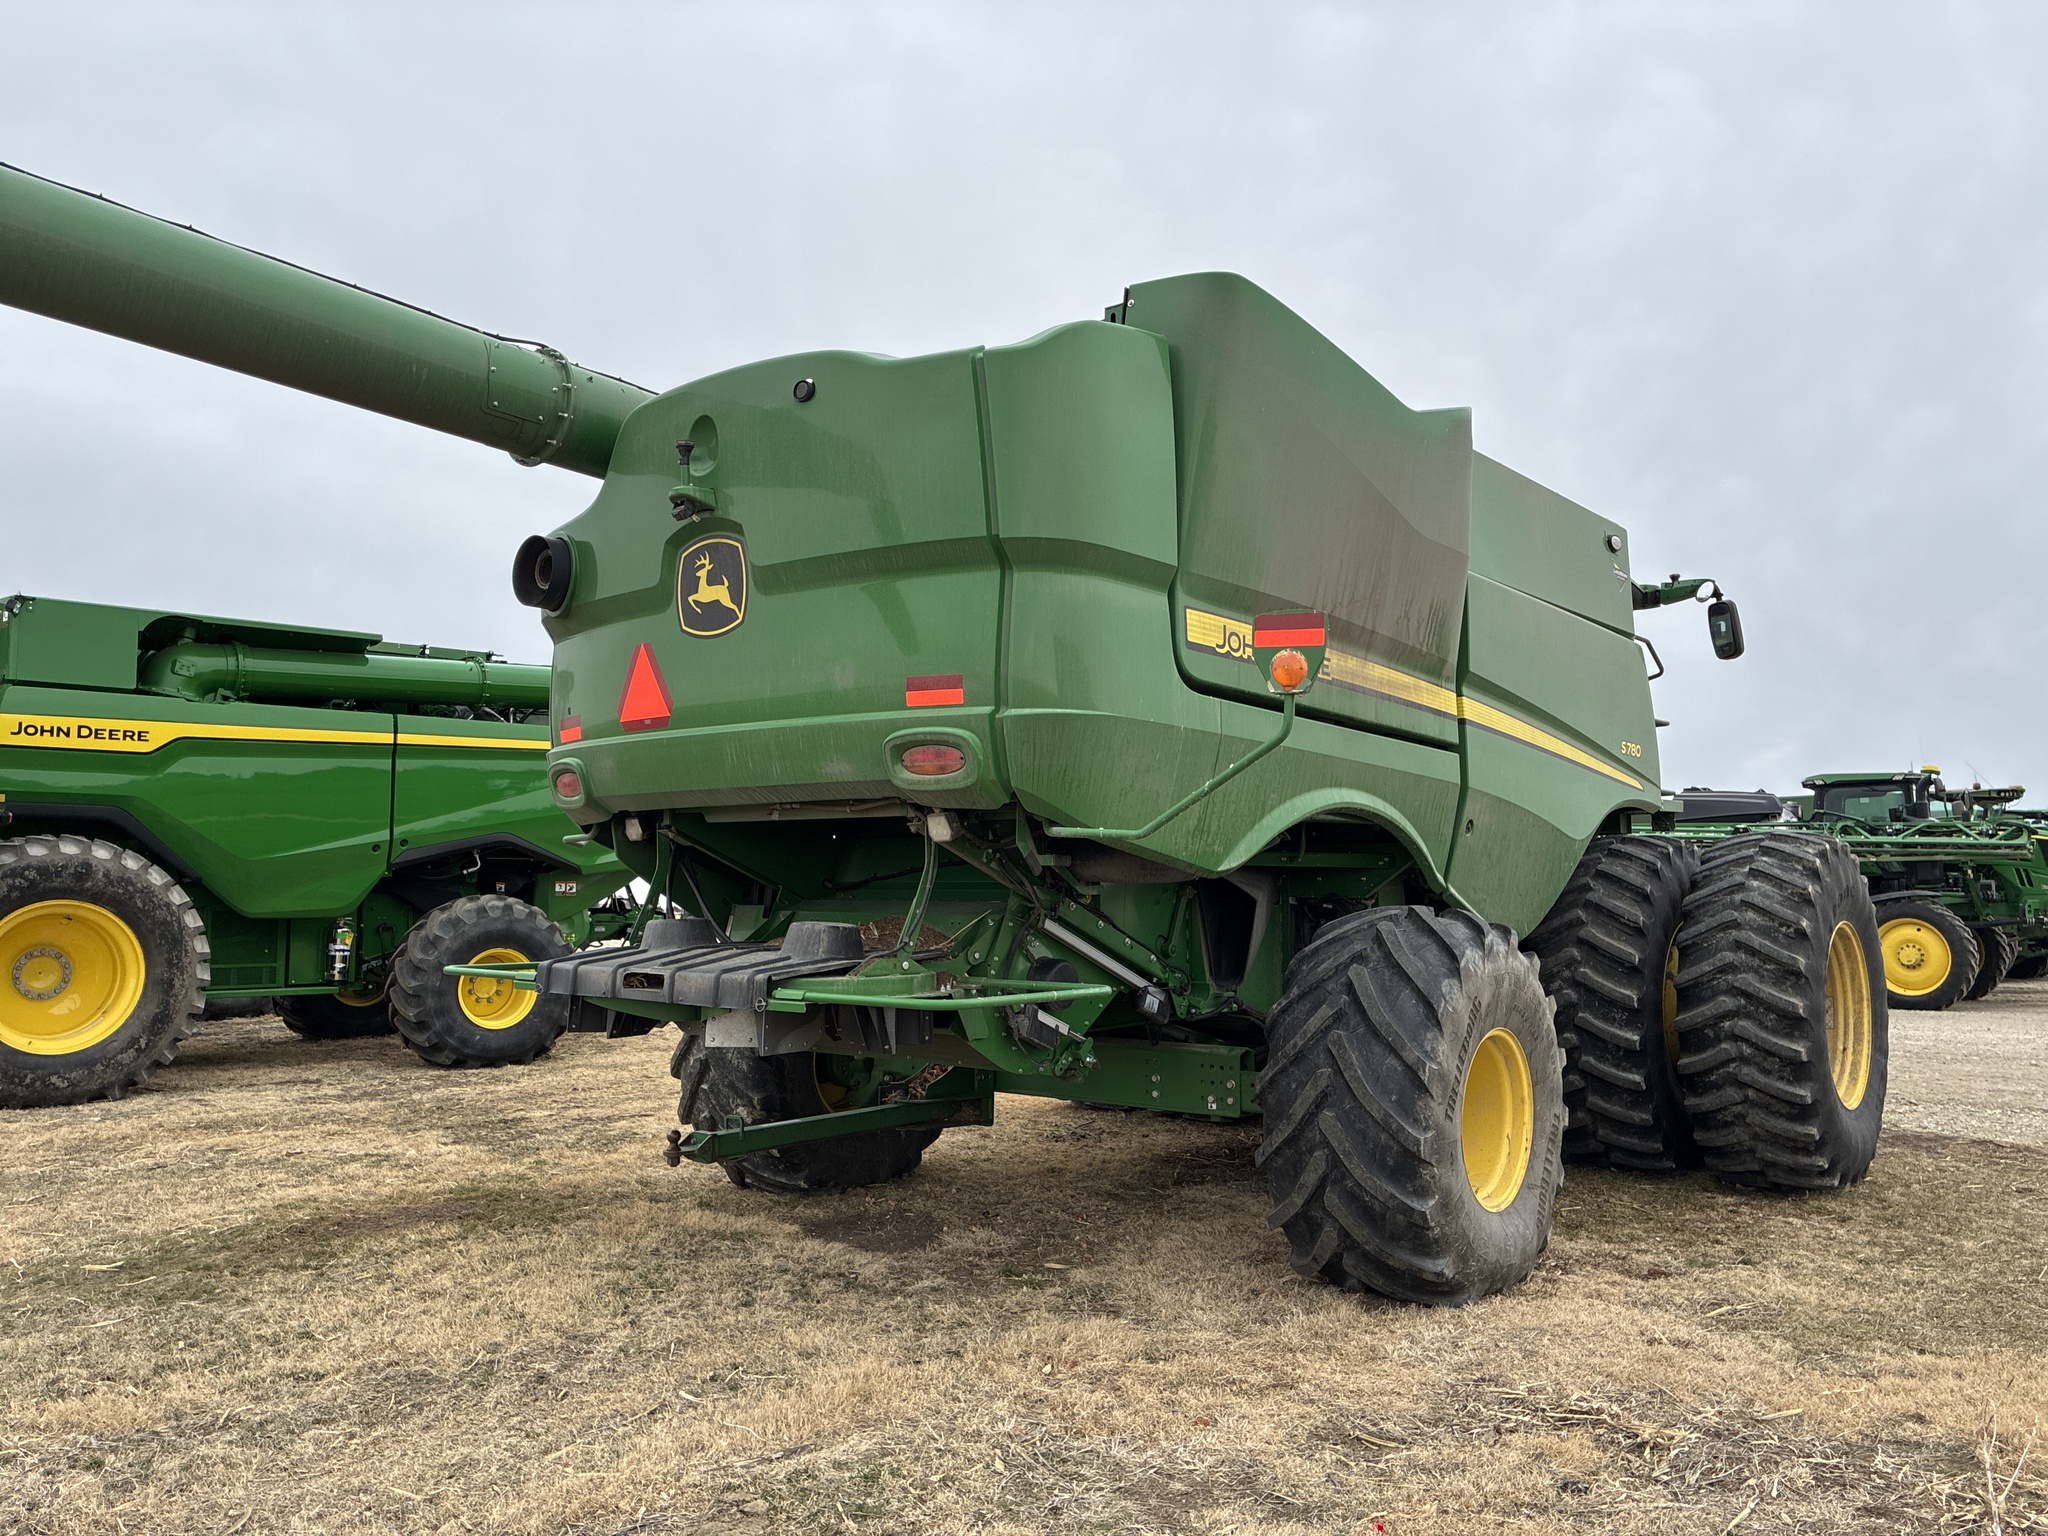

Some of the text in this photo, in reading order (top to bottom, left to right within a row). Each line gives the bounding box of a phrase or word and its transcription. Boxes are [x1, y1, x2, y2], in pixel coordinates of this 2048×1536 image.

[1216, 624, 1253, 656] JOH
[10, 721, 150, 742] JOHN DEERE
[1621, 740, 1641, 757] S780
[1444, 995, 1482, 1124] TRELLEBORG
